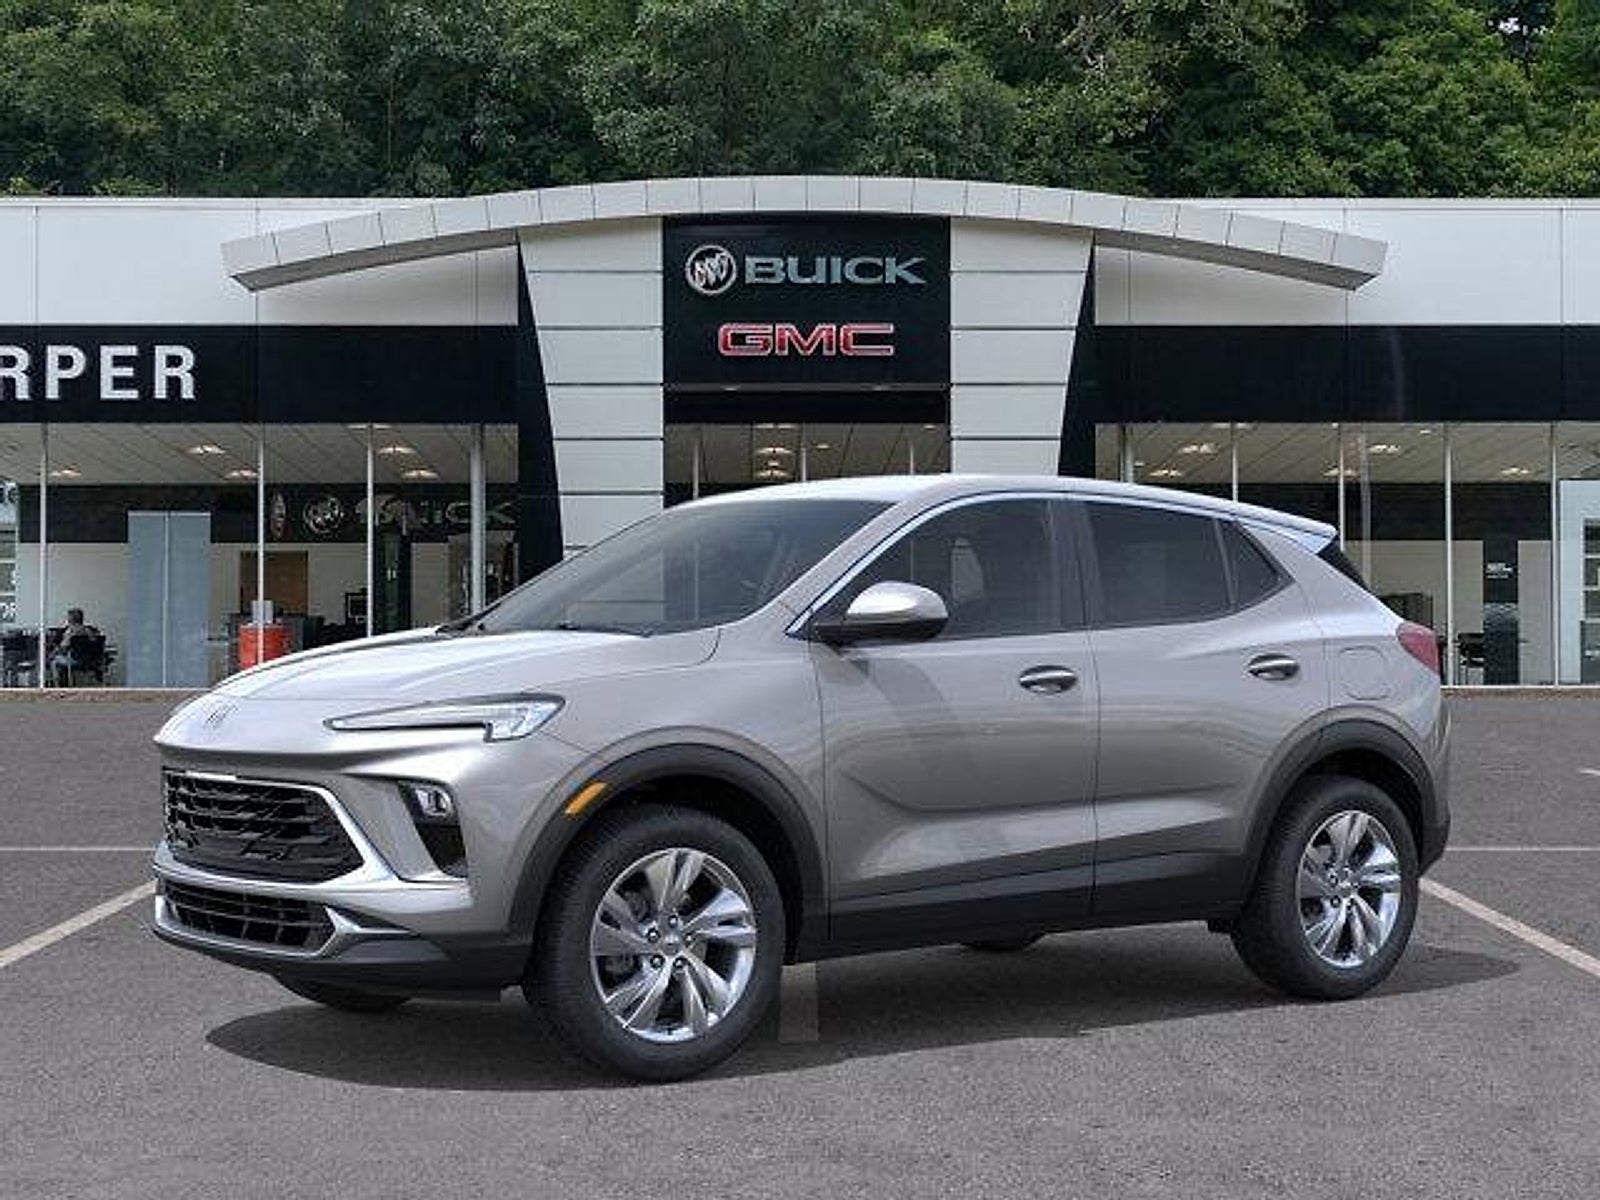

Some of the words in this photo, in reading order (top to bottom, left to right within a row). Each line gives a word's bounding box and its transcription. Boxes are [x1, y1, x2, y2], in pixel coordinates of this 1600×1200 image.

[745, 257, 926, 284] BUICK
[718, 323, 894, 356] GMC
[0, 345, 195, 399] RPER
